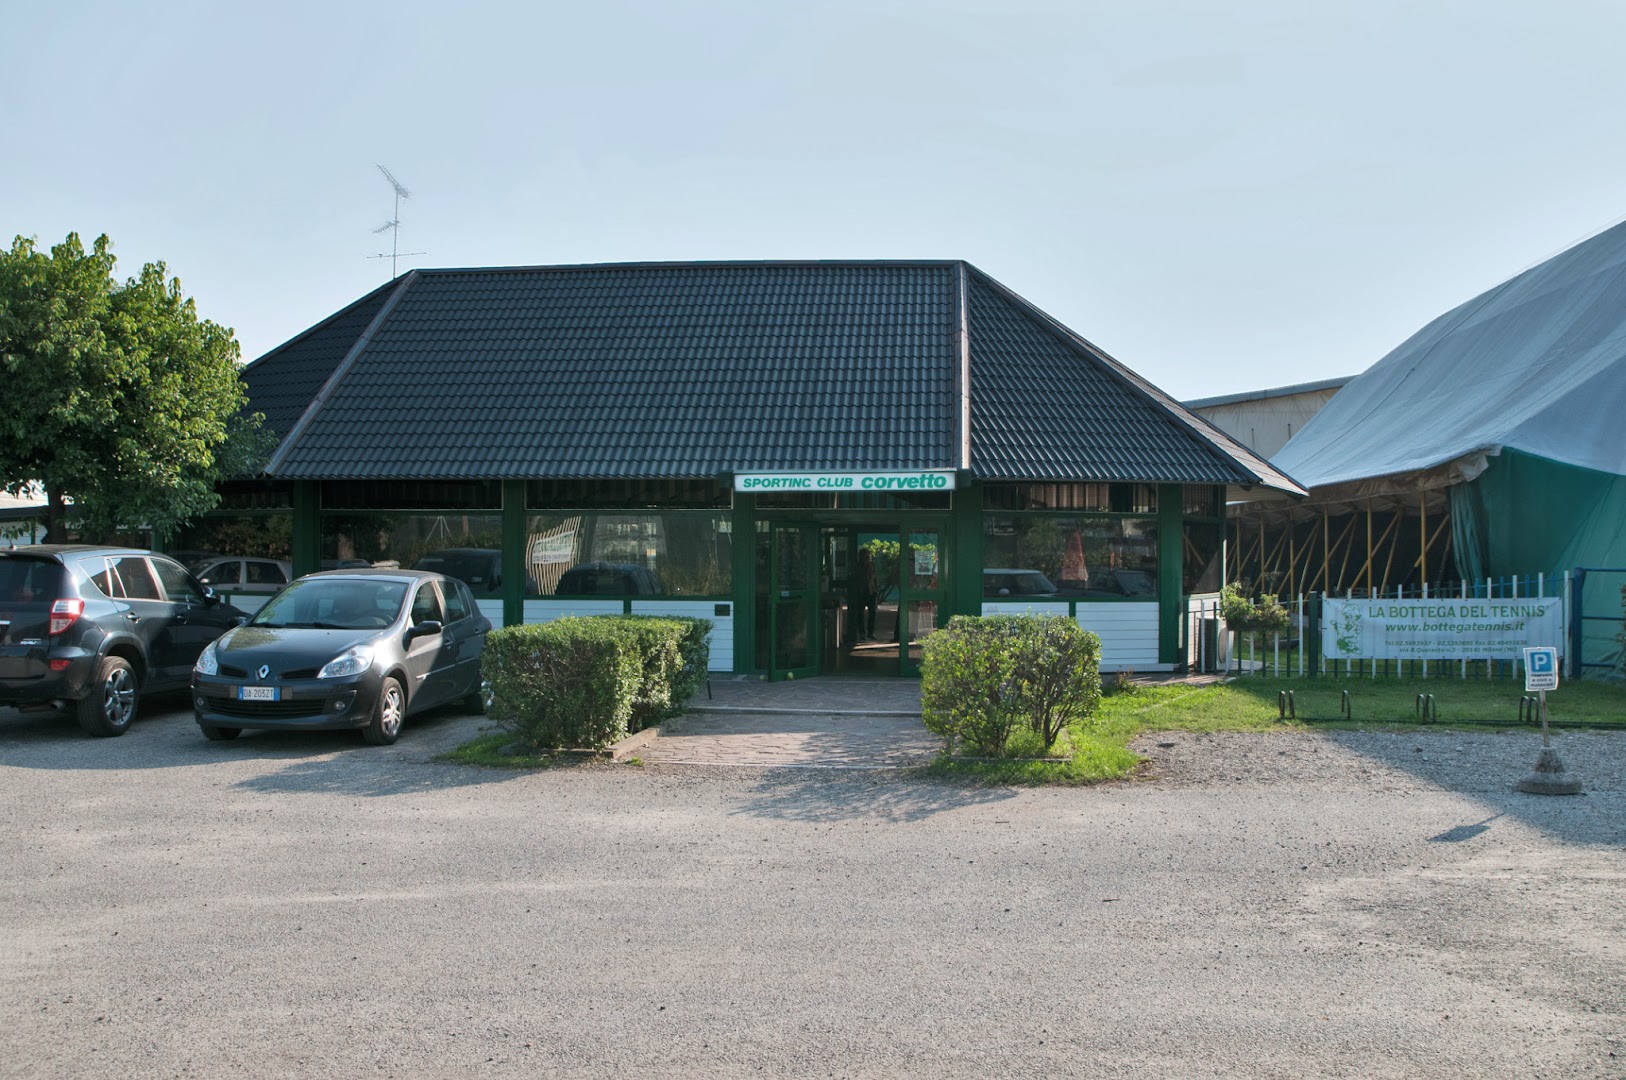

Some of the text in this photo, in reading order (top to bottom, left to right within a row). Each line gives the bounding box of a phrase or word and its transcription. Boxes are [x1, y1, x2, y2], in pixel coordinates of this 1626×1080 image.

[817, 477, 853, 488] CLUB
[861, 474, 947, 489] corvetto
[1368, 605, 1545, 618] LA BOTTEGA DEL TENNIS
[1385, 621, 1525, 634] www.bottegatennis.it
[1534, 654, 1548, 670] P
